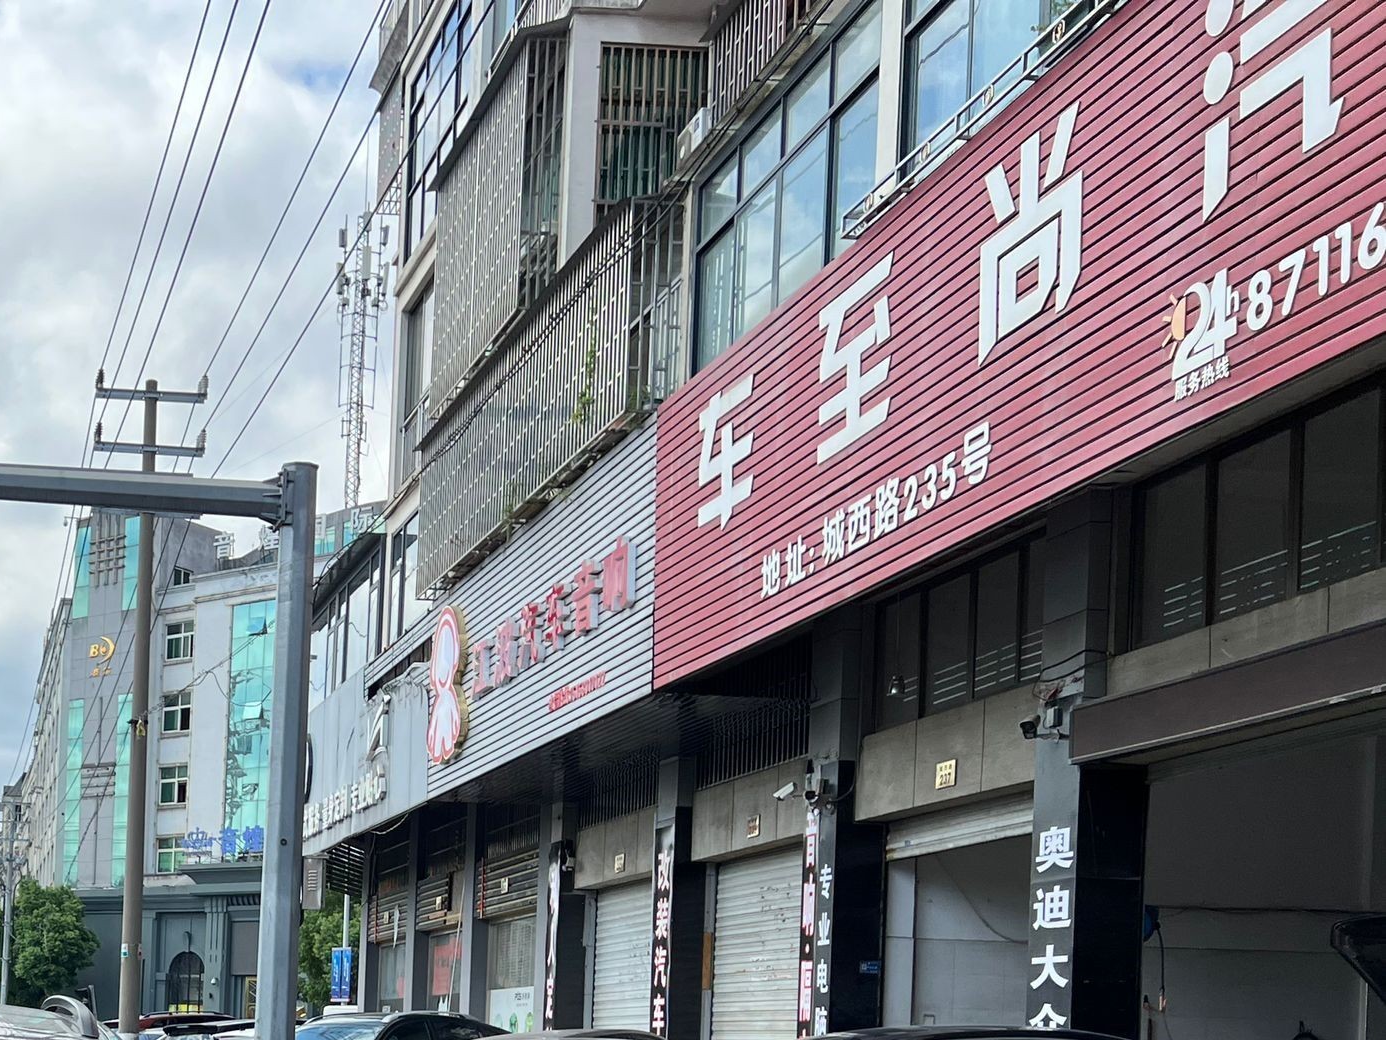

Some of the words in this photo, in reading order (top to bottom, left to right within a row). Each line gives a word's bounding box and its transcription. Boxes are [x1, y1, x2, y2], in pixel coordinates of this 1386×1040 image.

[1246, 202, 1386, 331] 87116
[1174, 356, 1231, 401] 服务热线
[652, 850, 671, 1036] 改装汽车
[814, 864, 832, 1036] 专业电脑
[1030, 826, 1074, 1028] 奥迪大众
